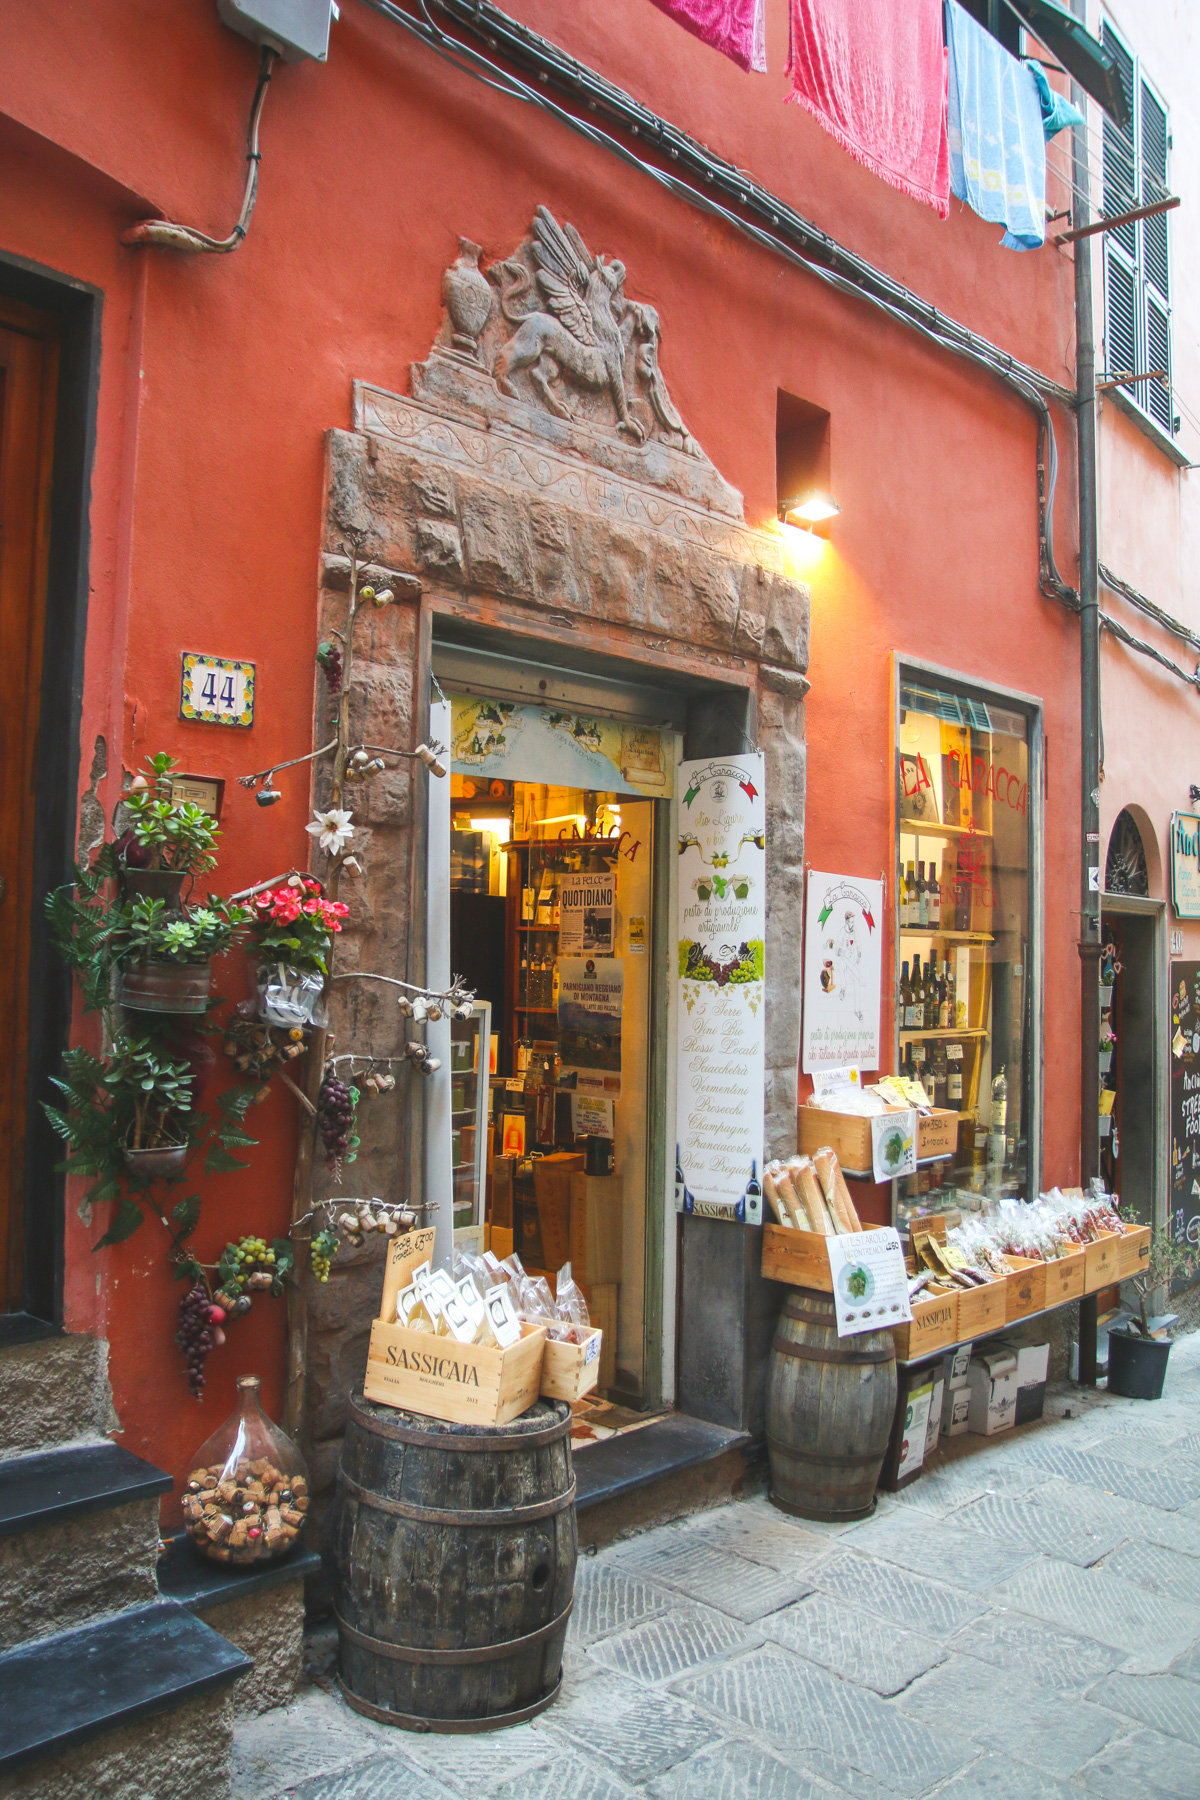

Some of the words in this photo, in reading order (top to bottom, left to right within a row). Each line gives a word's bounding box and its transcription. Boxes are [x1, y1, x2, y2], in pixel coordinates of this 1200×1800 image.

[201, 673, 234, 708] 44
[691, 770, 706, 786] La
[708, 762, 746, 781] Caracca
[899, 751, 931, 797] LA
[947, 750, 1028, 818] CARACCA
[712, 808, 745, 833] Ligure
[558, 820, 642, 863] CARACCA
[562, 888, 613, 910] QUOTIDIANO
[939, 884, 999, 909] ENOTECA
[683, 903, 703, 924] pesto
[704, 901, 712, 917] di
[714, 900, 758, 924] produzione
[697, 916, 739, 940] artigianale
[1172, 930, 1182, 951] 40
[688, 942, 713, 963] Vini
[562, 982, 594, 992] PARMIGIANO
[595, 983, 622, 994] REGGIANO
[573, 991, 580, 1001] DI
[580, 992, 610, 1002] MONTAGNA
[696, 1002, 708, 1016] 5
[711, 999, 742, 1017] Terre
[692, 1017, 717, 1036] Vini
[720, 1018, 744, 1036] Bio
[681, 1035, 715, 1053] Rossi
[718, 1037, 760, 1056] Locali
[688, 1055, 749, 1076] Sciacchetrà
[690, 1074, 749, 1096] Vermentini
[694, 1094, 745, 1115] Prosecchi
[687, 1112, 750, 1139] Champagne
[685, 1130, 752, 1155] Franciacorta
[680, 1150, 705, 1171] Vini
[708, 1154, 753, 1180] Pregiat
[916, 1306, 952, 1331] SASSICAIA
[385, 1345, 479, 1388] SASSICAIA
[383, 1376, 400, 1385] ITALIA
[418, 1377, 445, 1388] BOLGHERI
[466, 1396, 478, 1404] 2012
